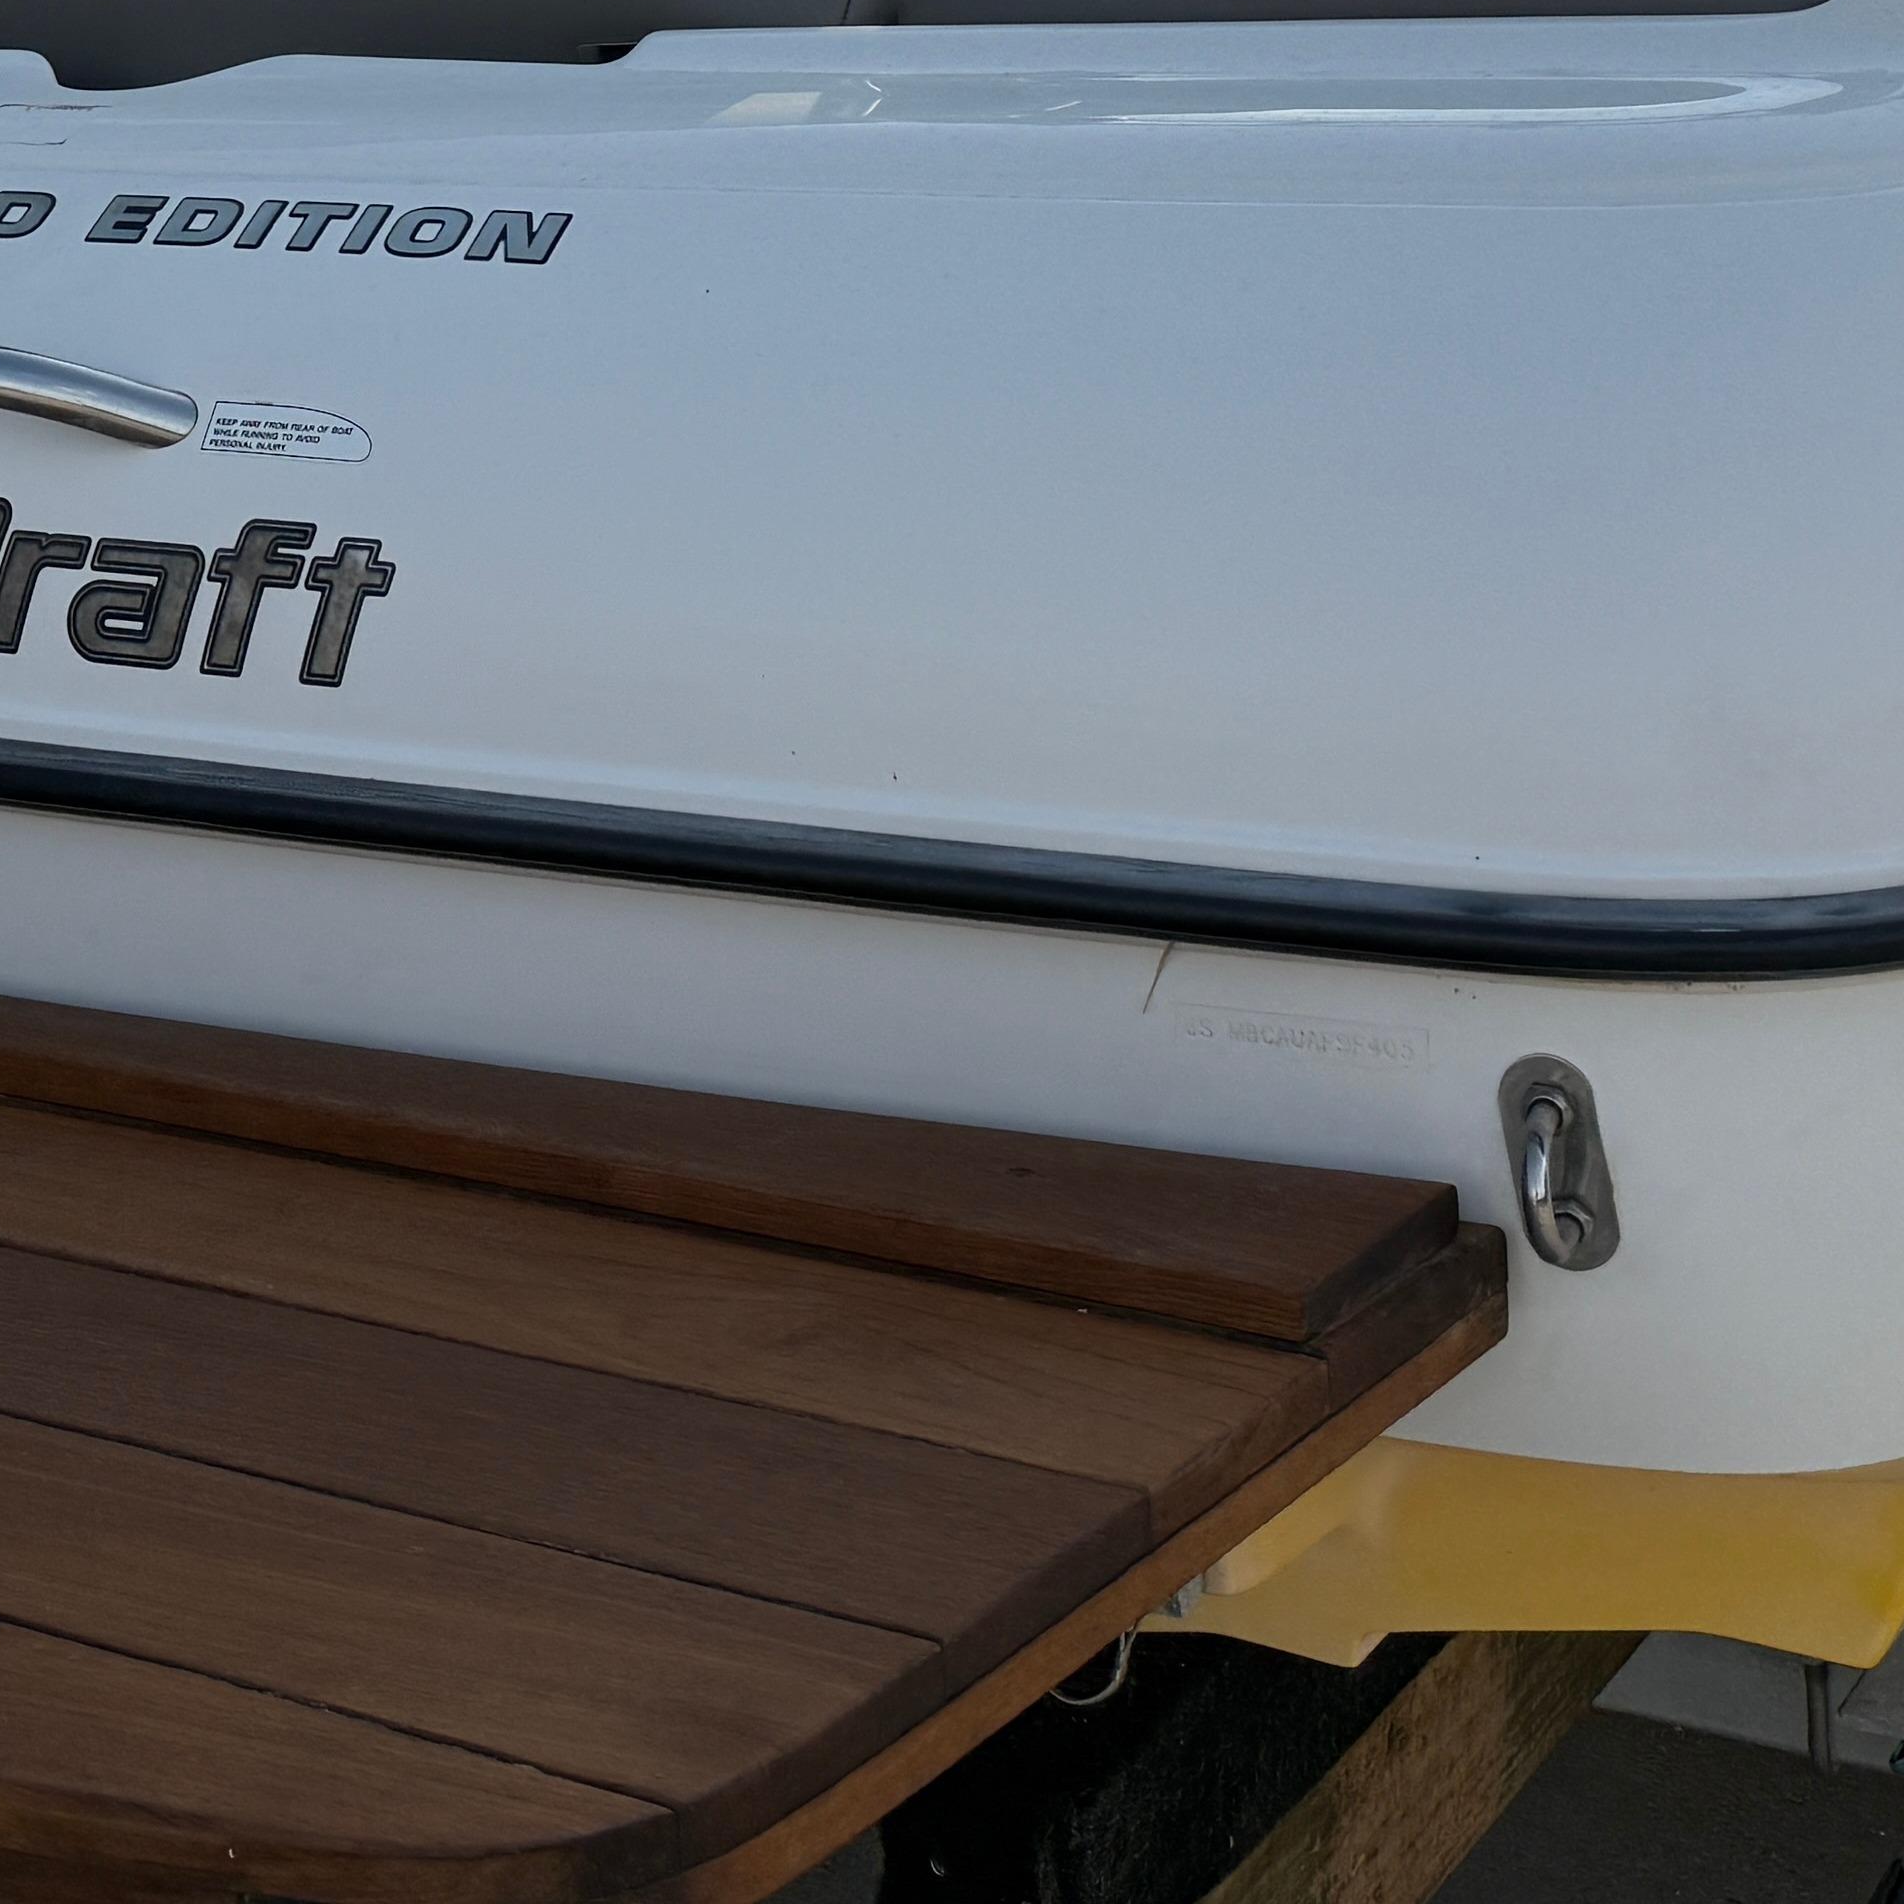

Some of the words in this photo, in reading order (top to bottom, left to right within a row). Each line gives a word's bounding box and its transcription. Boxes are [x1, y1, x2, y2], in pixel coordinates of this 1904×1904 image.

[84, 194, 574, 266] EDITION
[215, 417, 238, 426] KEEP
[239, 420, 261, 428] AWAY
[263, 421, 289, 430] FROM
[290, 423, 315, 432] REAR
[316, 425, 329, 433] OF
[331, 426, 354, 435] BOAT
[209, 438, 253, 449] PERSONAL
[213, 428, 239, 437] WHILE
[240, 429, 279, 440] RUNNING
[281, 433, 294, 441] TO
[295, 434, 321, 443] AVOID
